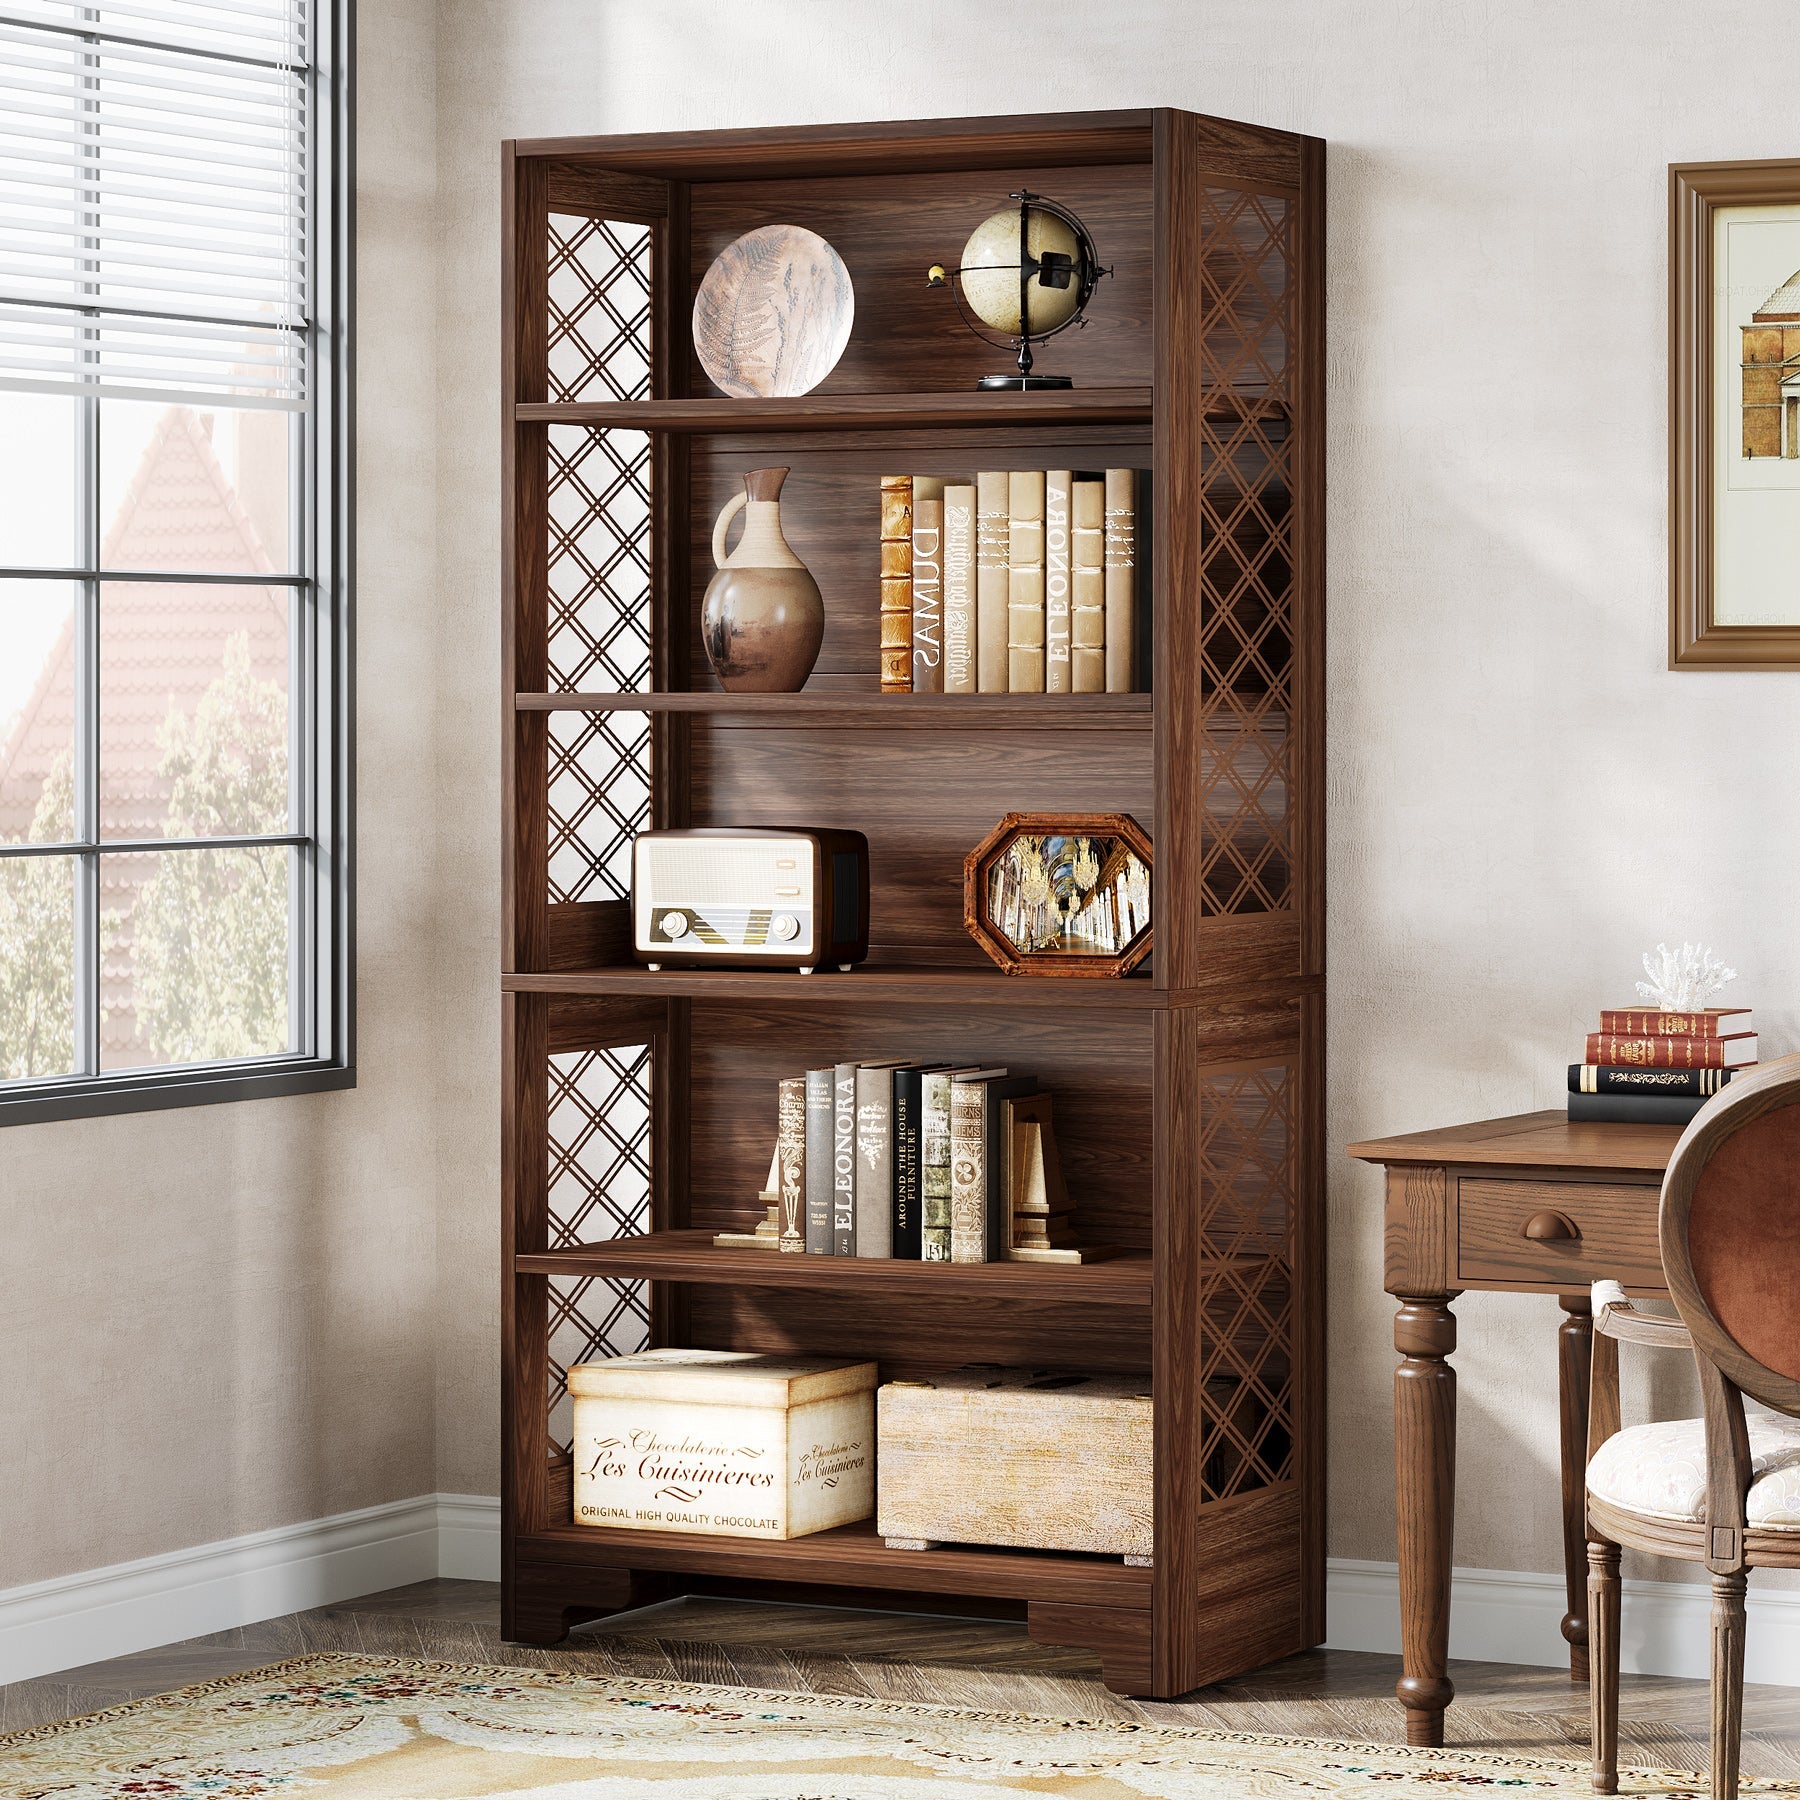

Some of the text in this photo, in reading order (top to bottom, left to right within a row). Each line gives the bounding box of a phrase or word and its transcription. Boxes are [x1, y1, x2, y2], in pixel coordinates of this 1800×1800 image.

[834, 1077, 854, 1231] ELEONORA
[898, 1098, 906, 1229] AROUND THE HOUSE
[907, 1127, 916, 1201] FURNITURE
[628, 1428, 729, 1456] Chocolaterie
[580, 1449, 774, 1487] Les Cuisinieres
[793, 1456, 865, 1486] Les Cuisinieres
[581, 1505, 779, 1530] ORIGINAL HIGH QUALITY CHOCOLATE
